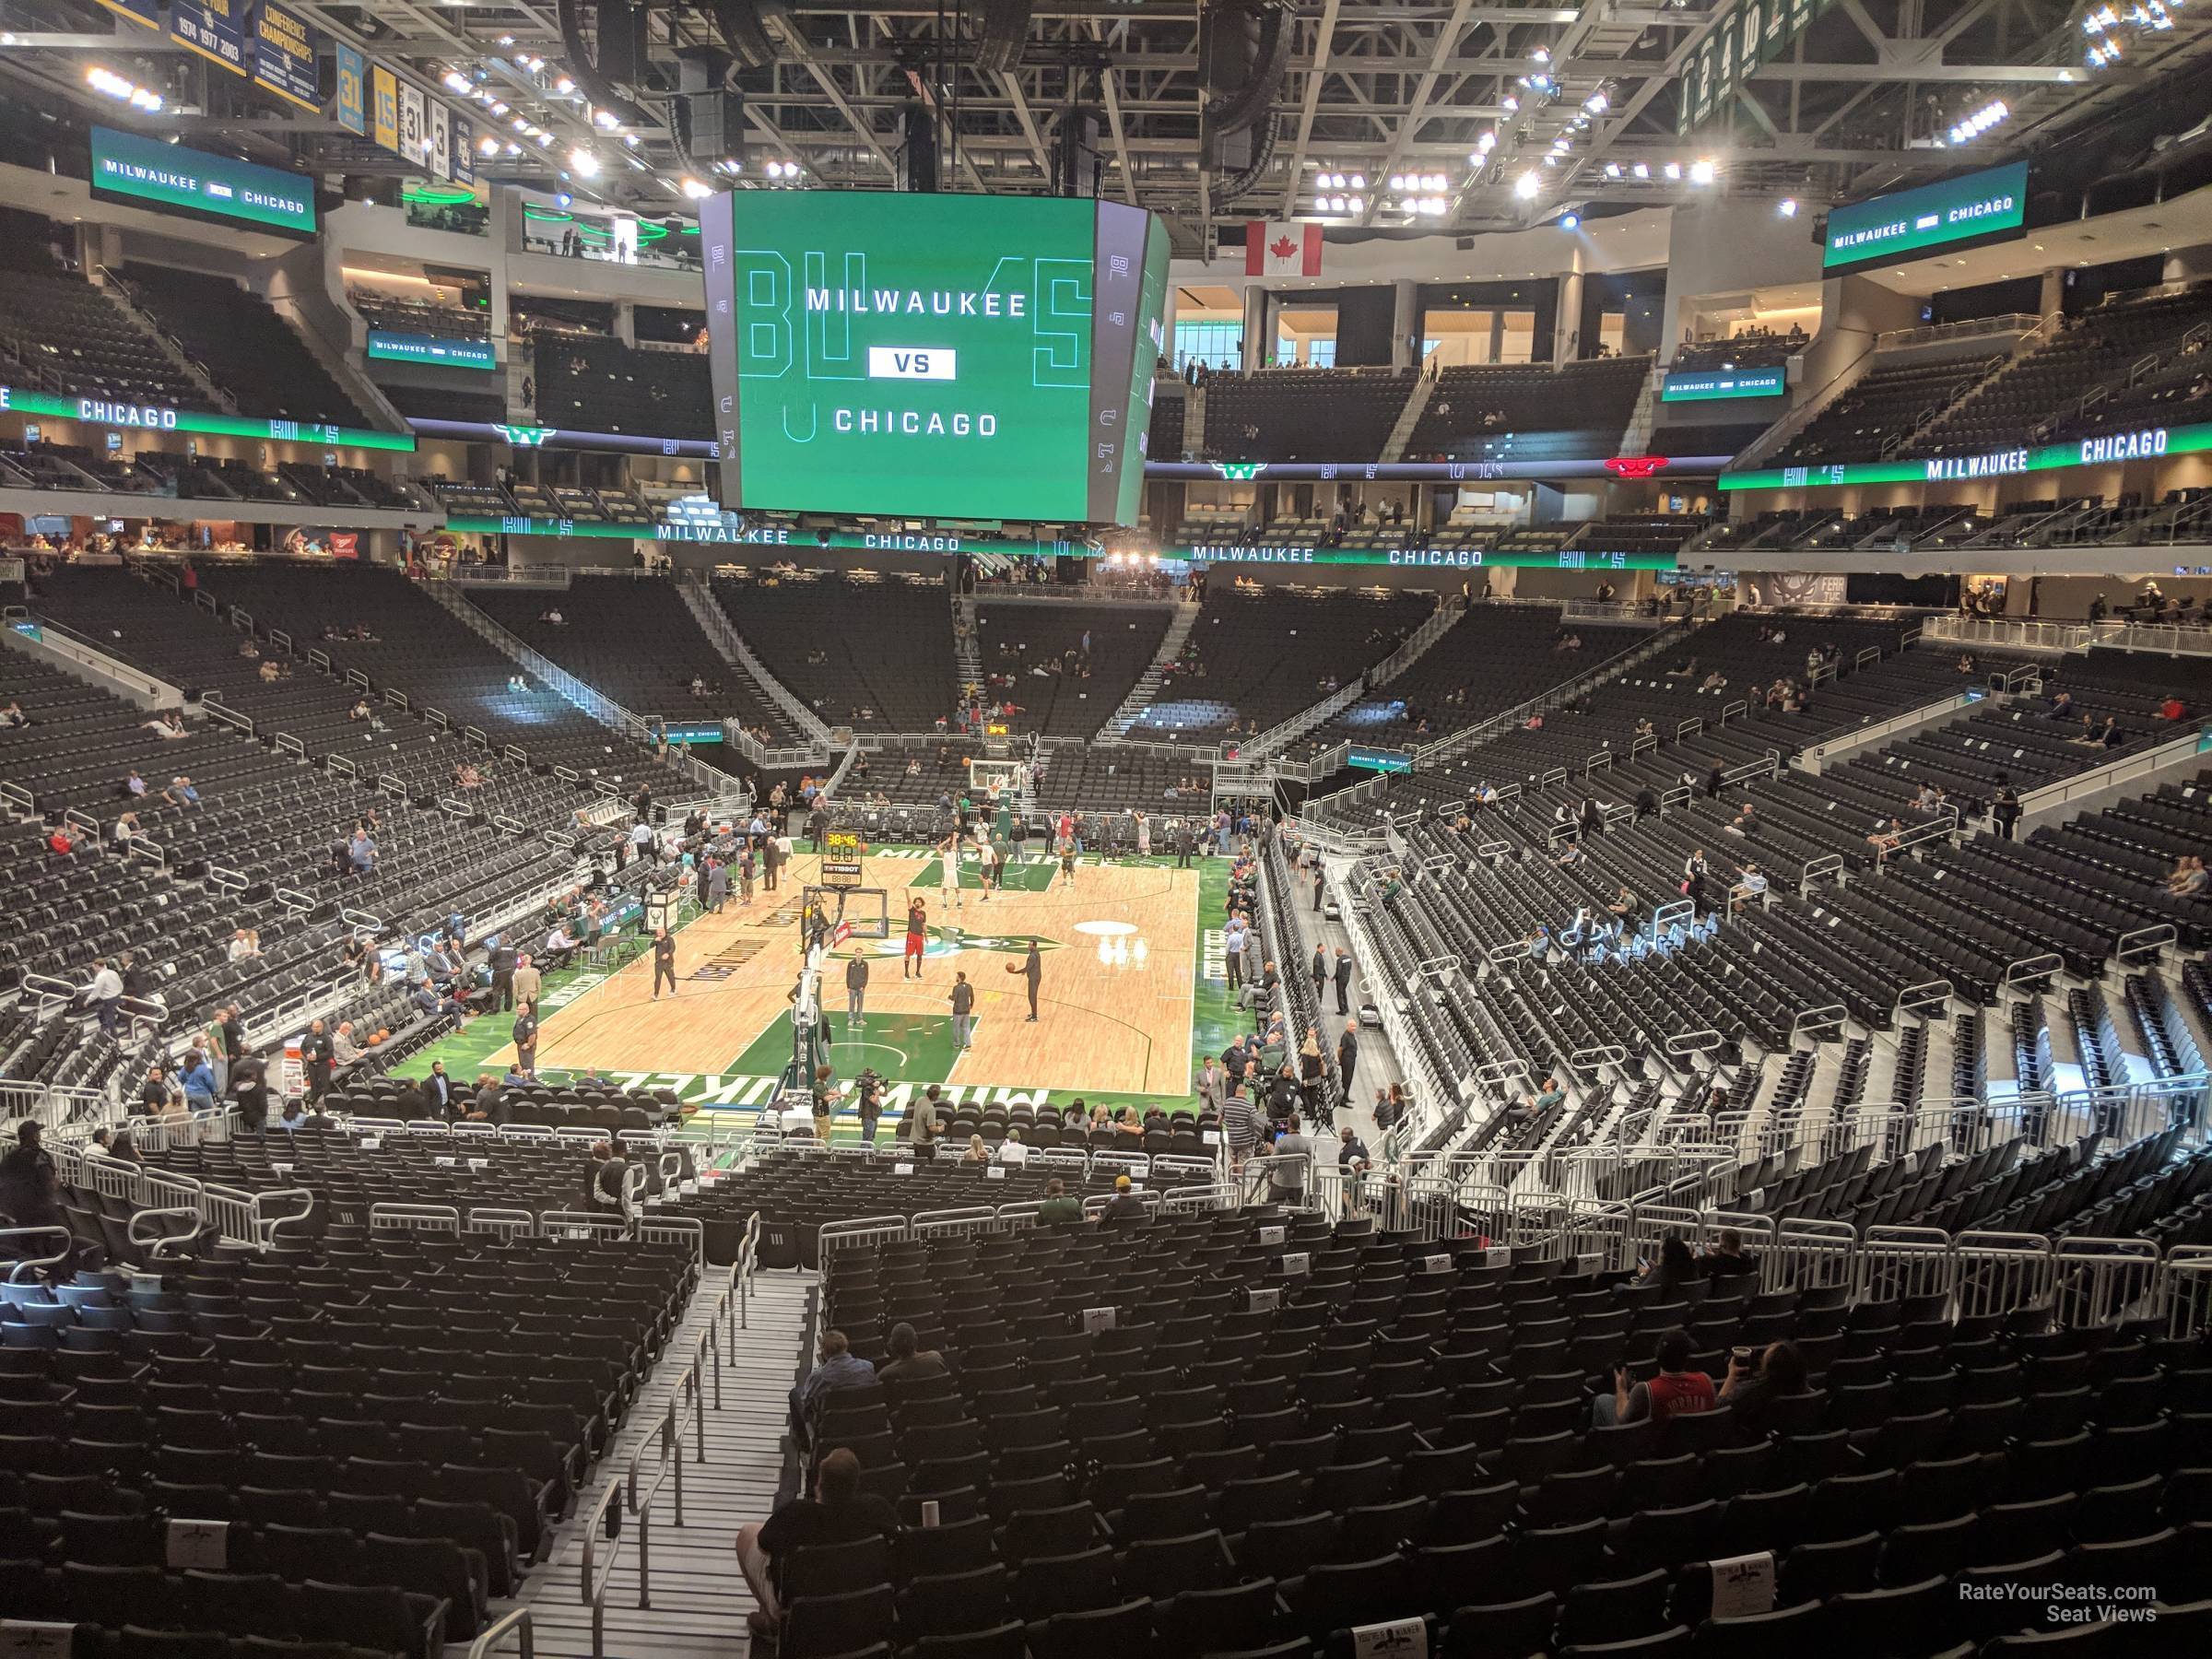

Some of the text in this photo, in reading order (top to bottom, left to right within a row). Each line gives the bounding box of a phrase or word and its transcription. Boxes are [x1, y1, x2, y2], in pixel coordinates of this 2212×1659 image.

[179, 17, 240, 62] 1974 1977 2003
[265, 5, 306, 42] CONFERENCE
[1742, 4, 1760, 61] 10
[259, 20, 312, 64] CHAMPIONSHIPS
[340, 68, 362, 114] 31
[1700, 55, 1711, 102] 2
[378, 89, 394, 130] 15
[406, 106, 421, 146] 31
[436, 123, 444, 157] 3
[104, 159, 197, 191] MILWAUKEE
[244, 192, 305, 214] CHICAGO
[1834, 197, 2014, 248] MILWAUKEE CHICAGO
[807, 288, 1025, 317] MILWAUKEE
[376, 342, 488, 359] MILWAUKEE CHICAGO
[894, 353, 930, 373] VS
[1669, 379, 1776, 392] MILWAUKEE CHICAGO
[80, 399, 177, 429] CHICAGO
[835, 409, 998, 437] CHICAGO
[1927, 429, 2167, 480] MILWAUKEE CHICAGO
[657, 525, 959, 552] MILWAUKEE CHICAGO
[1193, 546, 1483, 566] MILWAUKEE CHICAGO
[1821, 577, 1843, 592] FEAR
[828, 833, 857, 846] 38:46
